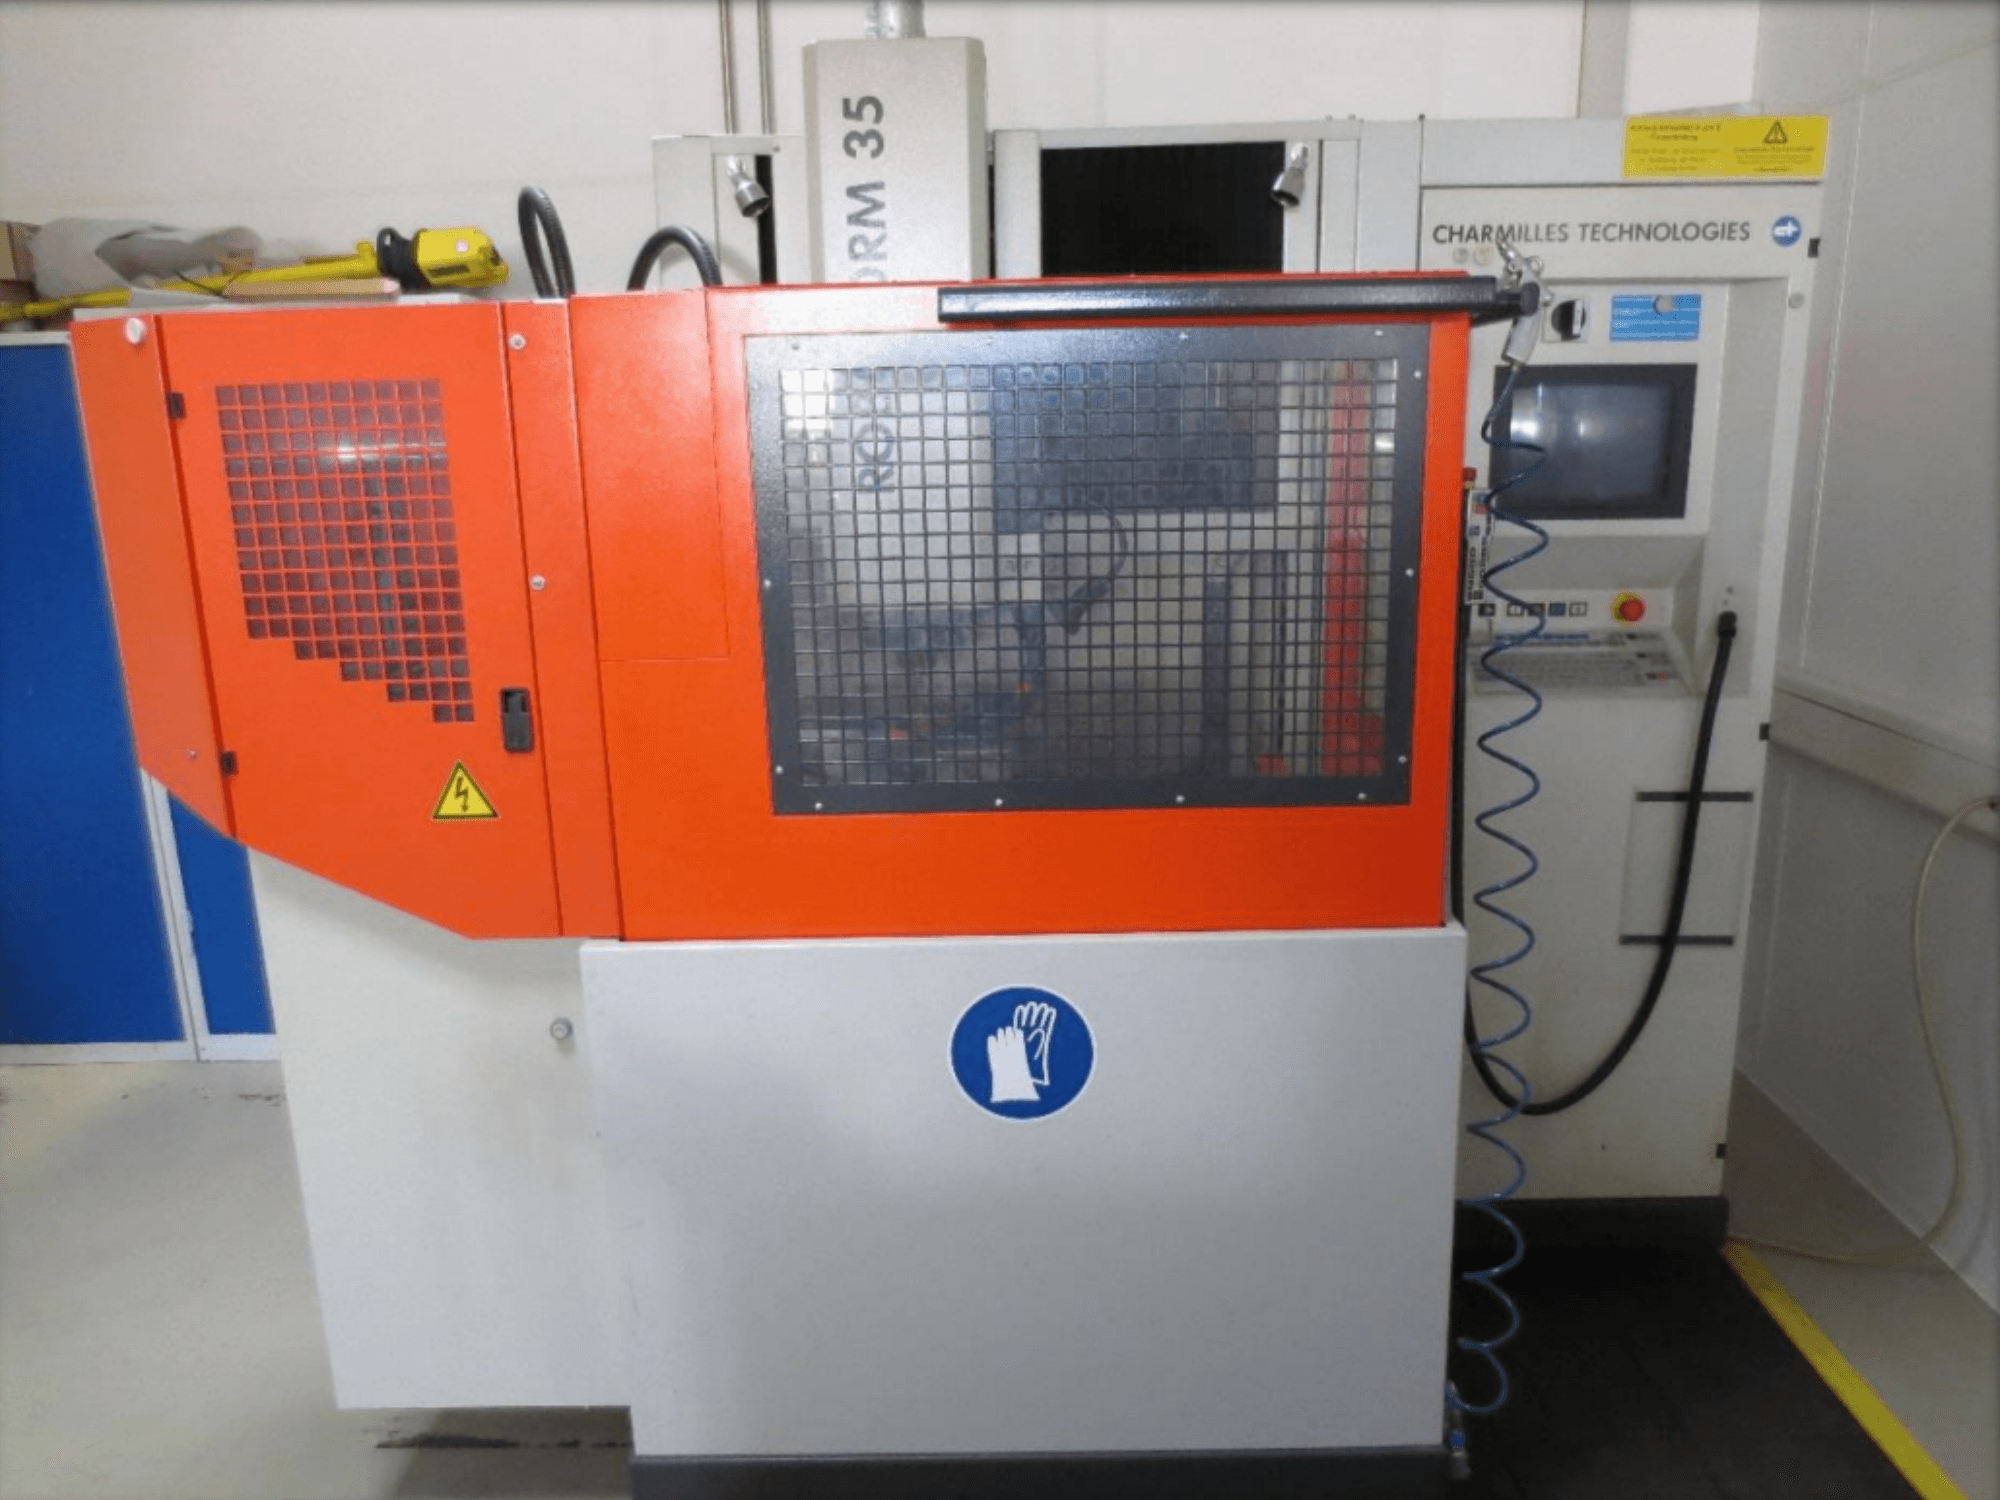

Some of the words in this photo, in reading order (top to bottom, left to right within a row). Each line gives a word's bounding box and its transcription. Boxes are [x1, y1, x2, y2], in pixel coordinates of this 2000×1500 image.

[842, 95, 884, 159] 35
[1432, 223, 1568, 244] CHARMILLES
[1578, 221, 1751, 242] TECHNOLOGIES
